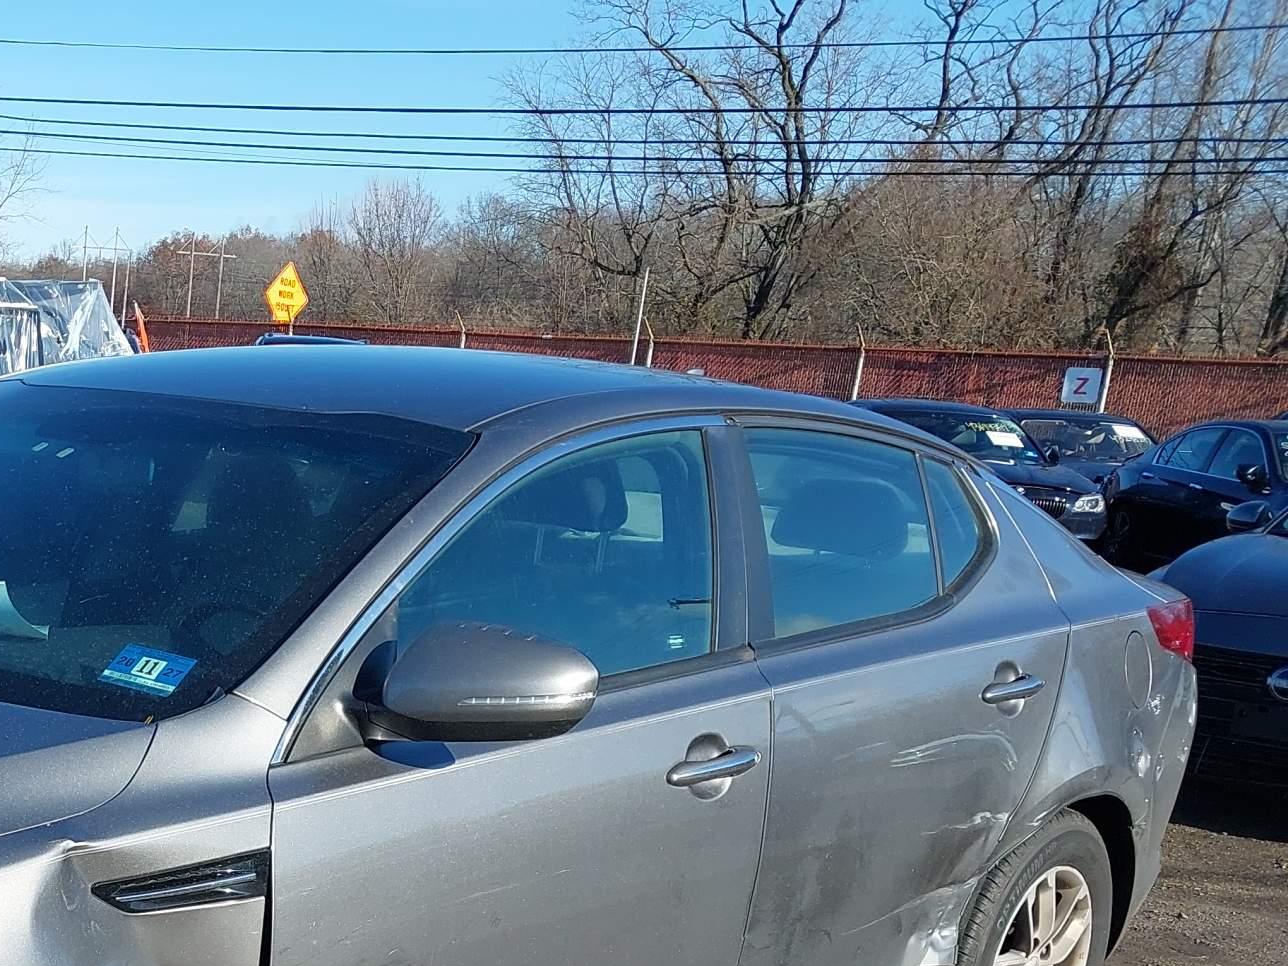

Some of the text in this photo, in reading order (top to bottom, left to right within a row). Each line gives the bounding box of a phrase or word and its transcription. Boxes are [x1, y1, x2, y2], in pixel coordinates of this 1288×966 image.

[280, 277, 296, 288] ROAD
[278, 290, 294, 299] WORK
[1073, 377, 1090, 395] Z
[116, 655, 185, 679] 20 11 27
